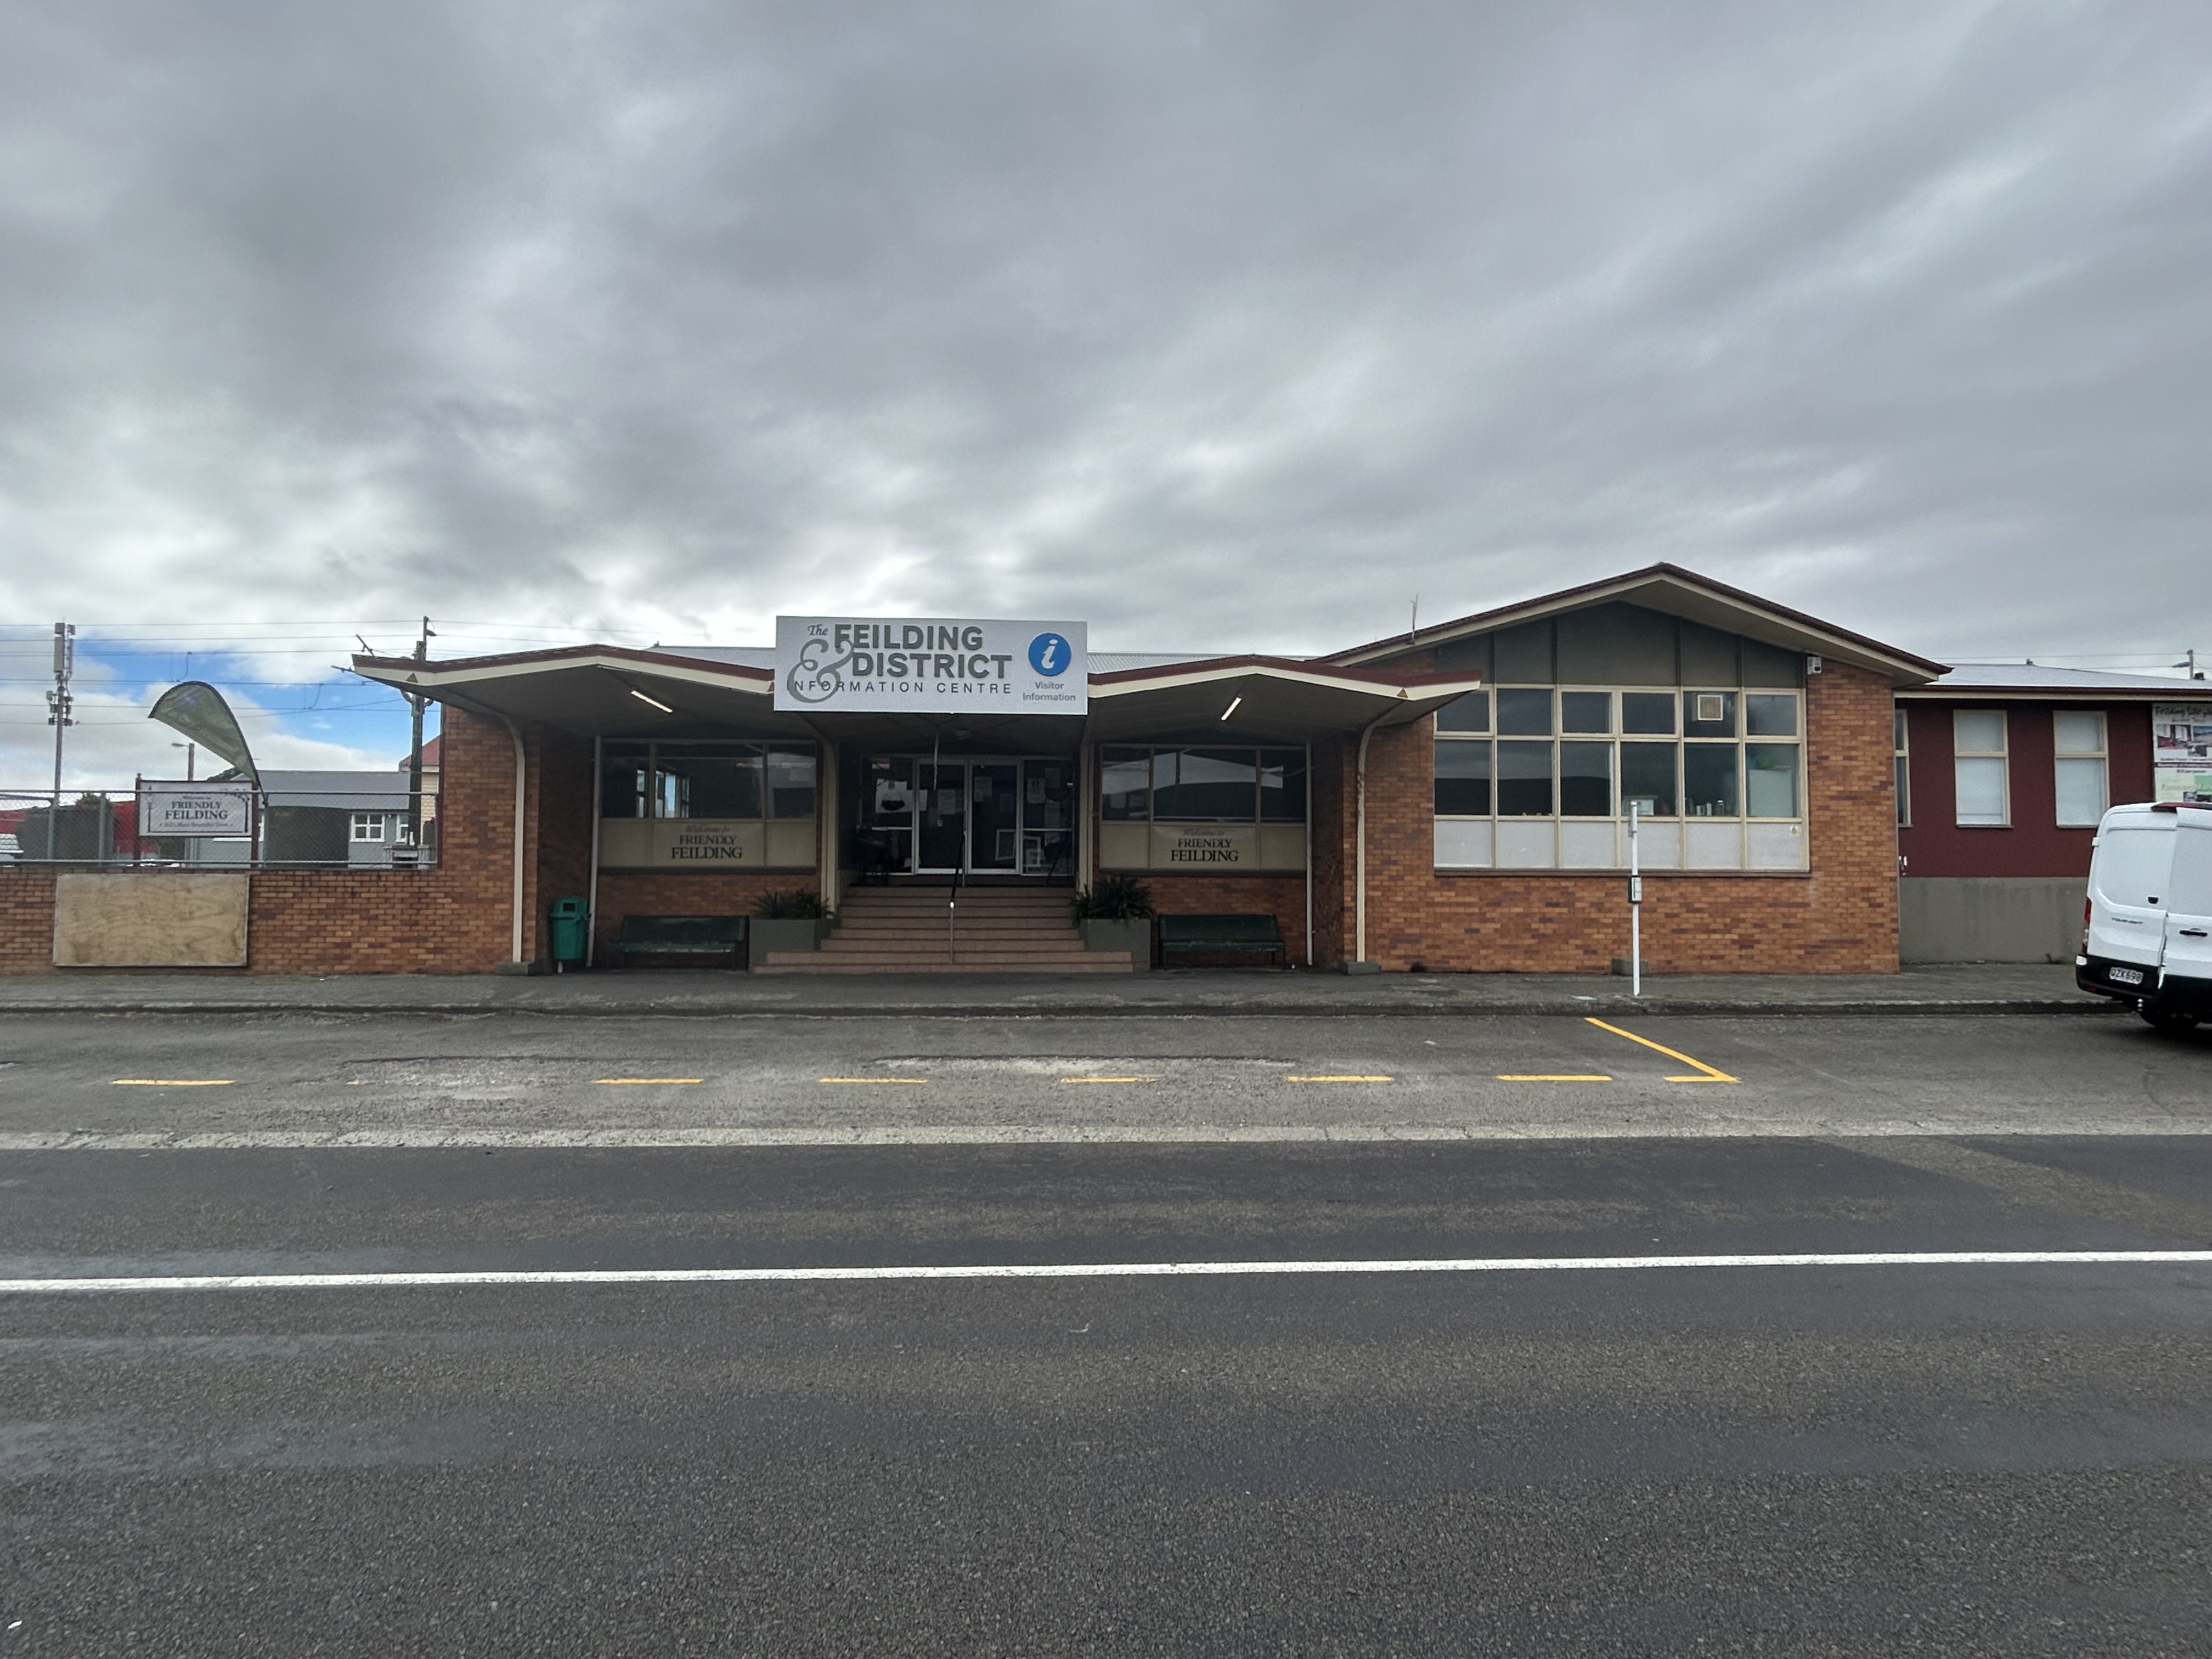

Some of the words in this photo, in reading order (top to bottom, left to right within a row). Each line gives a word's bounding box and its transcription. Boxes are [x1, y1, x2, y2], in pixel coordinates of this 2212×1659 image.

[808, 624, 828, 636] The
[834, 624, 983, 651] FEILDING
[853, 652, 1012, 679] DISTRICT
[936, 682, 1011, 695] CENTRE
[1034, 681, 1065, 690] Visitor
[1023, 692, 1076, 701] Information
[171, 801, 221, 809] FRIENDLY
[165, 810, 228, 820] FEILDING
[685, 825, 720, 833] Welcome
[1183, 827, 1216, 836] Welcome
[679, 834, 737, 845] FRIENDLY
[1177, 838, 1232, 848] FRIENDLY
[670, 846, 743, 859] FEILDING
[1170, 849, 1239, 862] FEILDING
